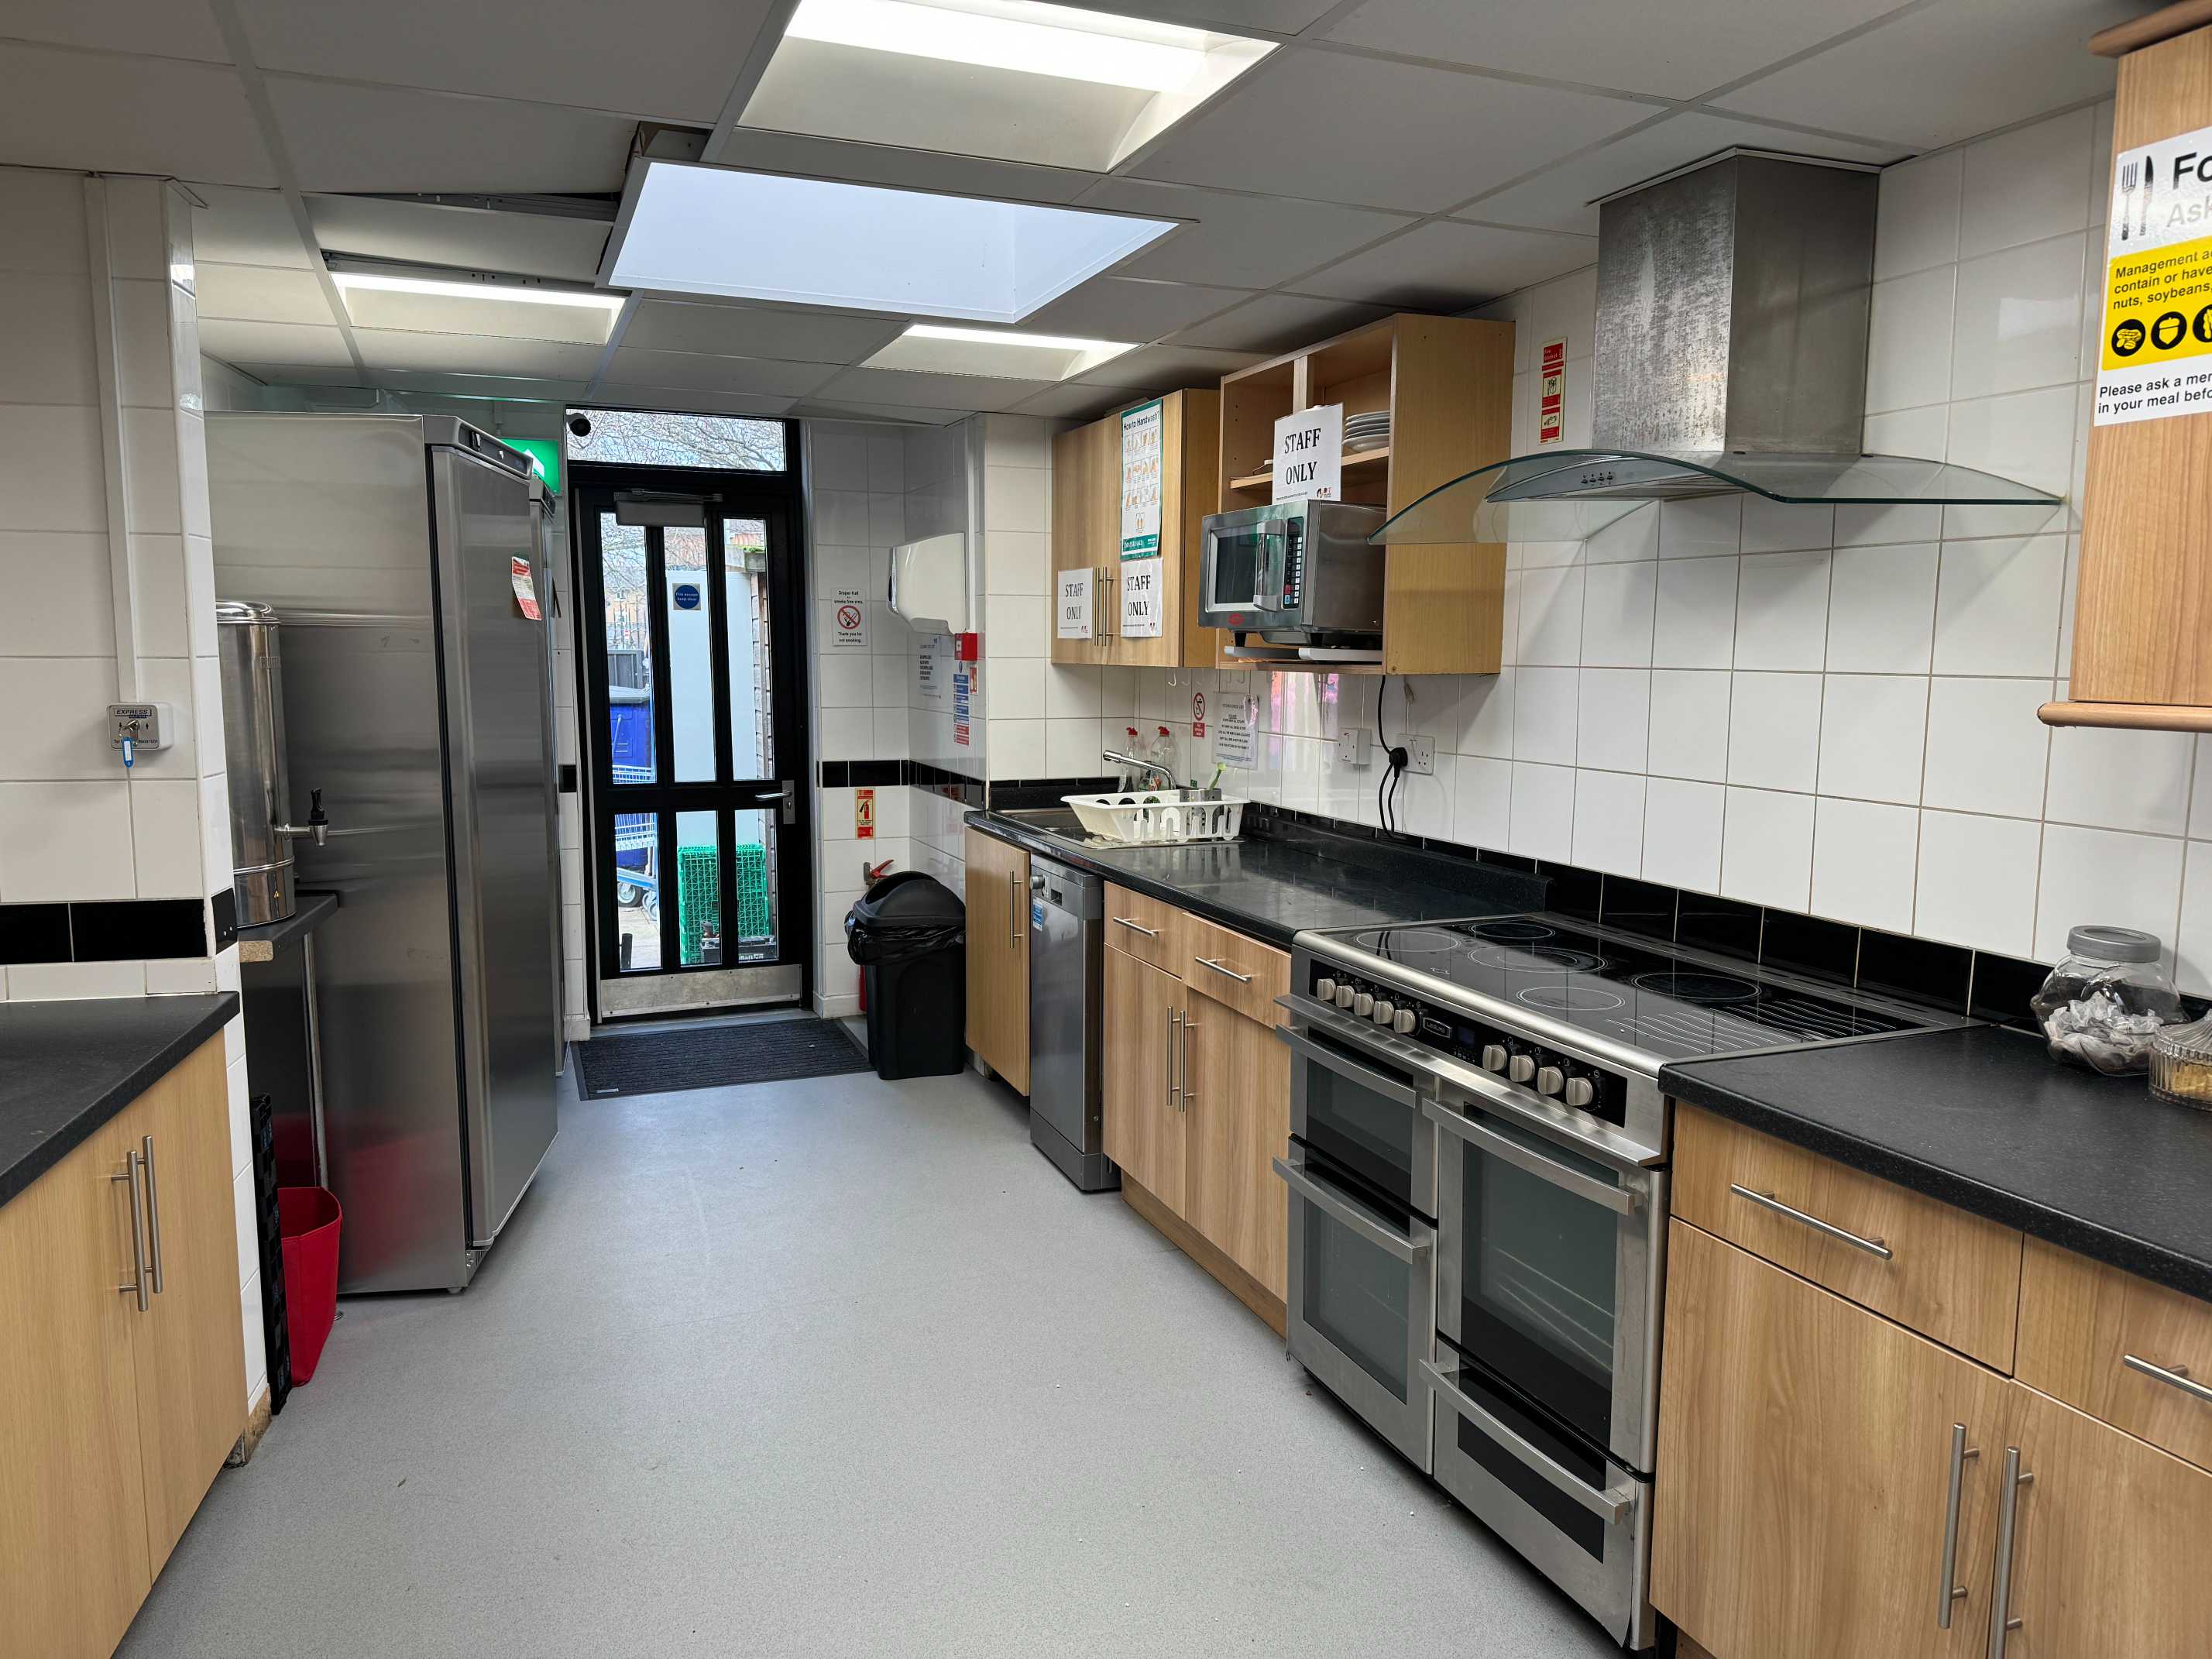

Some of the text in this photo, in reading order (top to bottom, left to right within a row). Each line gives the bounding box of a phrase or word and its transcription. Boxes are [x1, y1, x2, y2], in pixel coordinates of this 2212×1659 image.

[2115, 252, 2197, 279] Management
[2114, 265, 2212, 294] contain or have
[2113, 297, 2143, 310] nuts,
[2100, 373, 2212, 398] Please ask a me
[2098, 403, 2109, 414] in
[2114, 399, 2143, 414] your
[2147, 392, 2179, 407] meal
[1123, 423, 1132, 431] How
[1285, 428, 1321, 454] STAFF
[1286, 462, 1317, 485] ONLY
[1065, 582, 1084, 597] STAFF
[1127, 575, 1151, 591] STAFF
[1066, 606, 1082, 620] ONLY
[1128, 601, 1149, 617] ONLY
